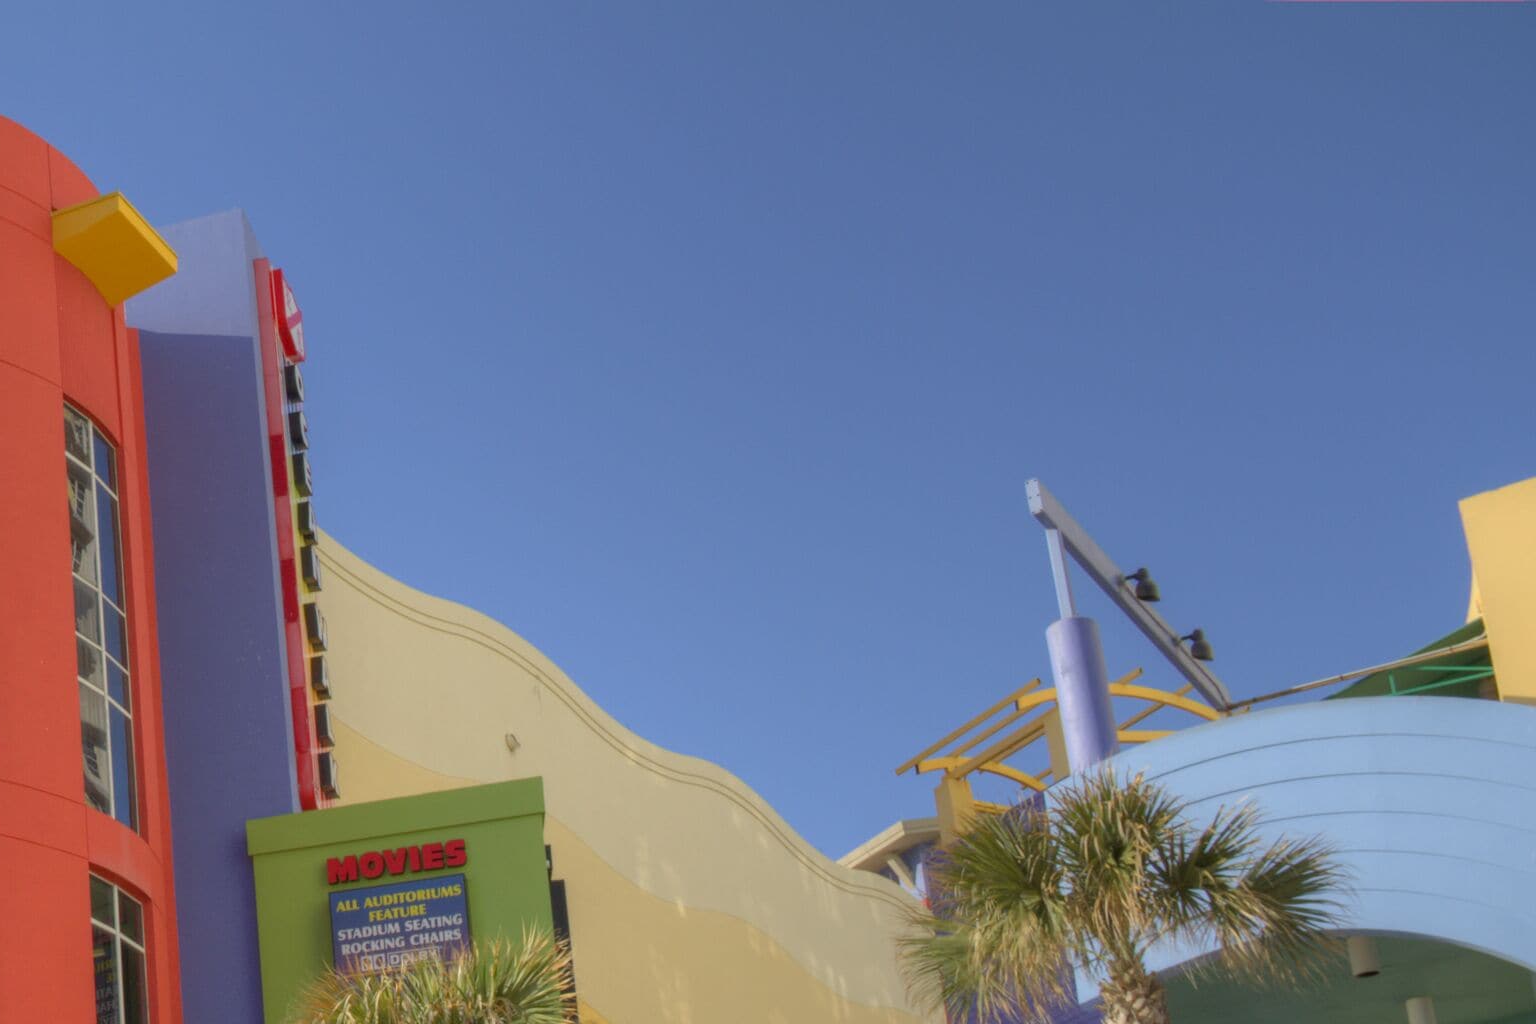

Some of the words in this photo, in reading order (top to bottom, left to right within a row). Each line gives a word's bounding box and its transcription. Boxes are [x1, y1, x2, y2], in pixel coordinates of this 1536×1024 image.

[326, 838, 467, 885] MOVIES
[336, 899, 360, 912] ALL
[364, 884, 462, 908] AUDITORIUMS
[337, 922, 401, 941] STADIUM
[404, 913, 462, 932] SEATING
[368, 903, 427, 923] FEATURE
[341, 937, 405, 955] ROCKING
[409, 928, 462, 946] CHAIRS
